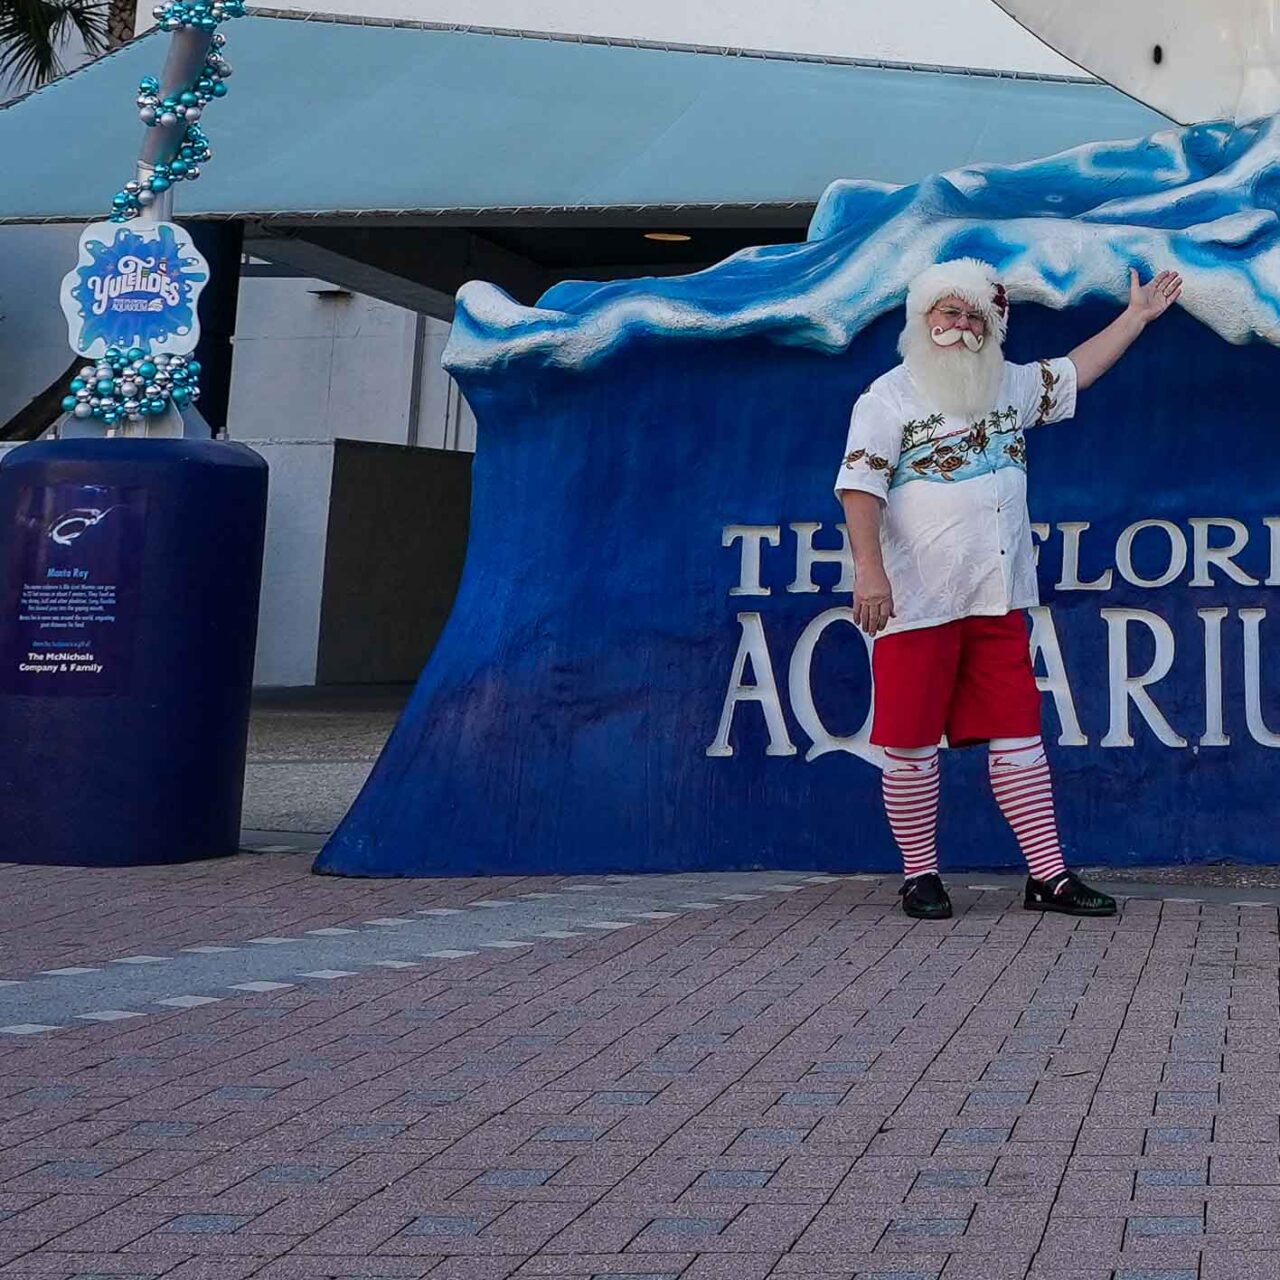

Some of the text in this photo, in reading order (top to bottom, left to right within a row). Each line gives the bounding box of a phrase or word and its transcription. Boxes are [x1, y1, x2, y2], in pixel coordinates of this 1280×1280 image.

[721, 520, 854, 596] TH
[28, 652, 94, 661] The McNichols
[19, 663, 103, 673] Company & Family
